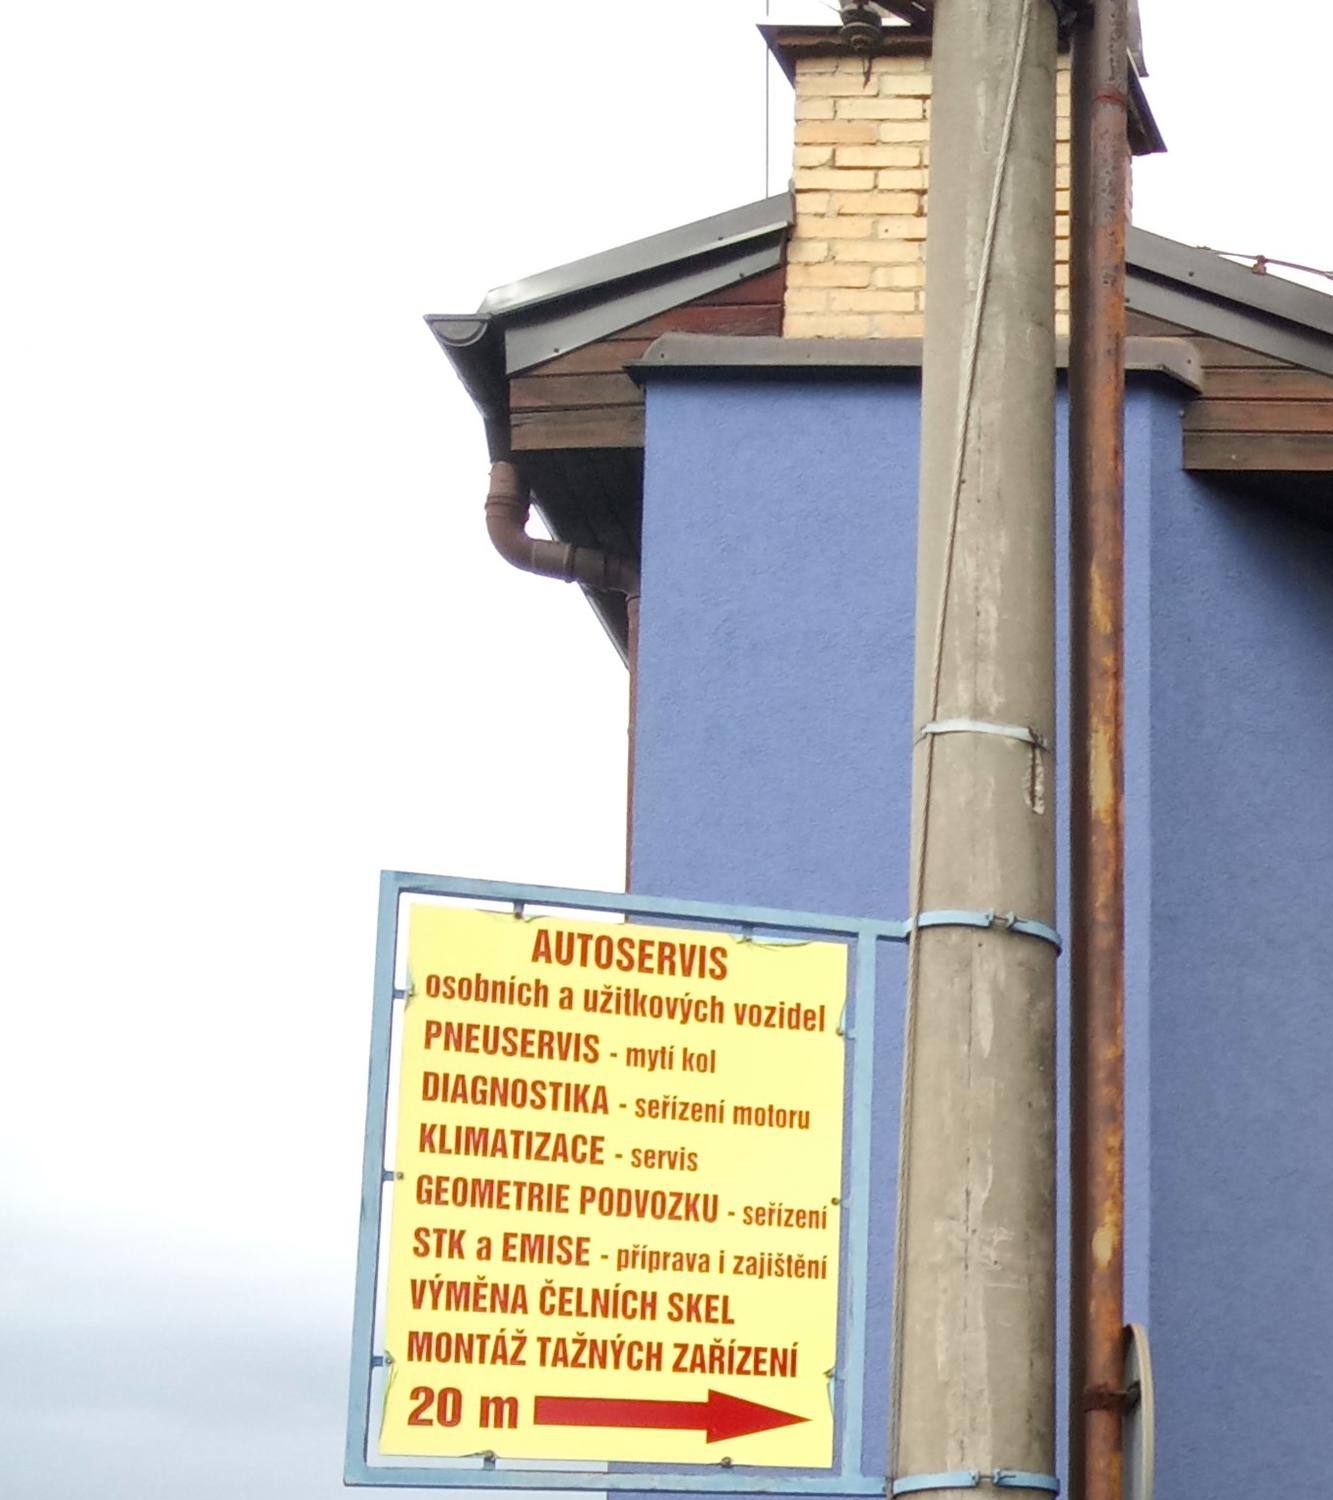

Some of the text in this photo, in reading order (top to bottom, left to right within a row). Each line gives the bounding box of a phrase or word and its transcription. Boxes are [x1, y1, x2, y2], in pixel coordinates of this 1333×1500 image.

[532, 928, 728, 981] AUTOSERVIS
[425, 972, 826, 1032] osobních a užitkových vozidel
[424, 1019, 600, 1064] PNEUSERVIS
[626, 1043, 675, 1072] mytí
[682, 1047, 716, 1074] kol
[422, 1071, 609, 1115] DIAGNOSTIKA
[635, 1094, 725, 1124] seřízení
[733, 1104, 811, 1130] motoru
[419, 1123, 605, 1165] KLIMATIZACE
[631, 1145, 698, 1172] servis
[416, 1174, 570, 1214] GEOMETRIE
[579, 1185, 719, 1223] PODVOZKU
[743, 1201, 828, 1230] seřízení
[412, 1227, 466, 1260] STK
[476, 1236, 492, 1261] a
[502, 1232, 591, 1267] EMISE
[616, 1244, 711, 1274] příprava
[719, 1249, 725, 1274] i
[732, 1251, 828, 1280] zajištění
[410, 1276, 735, 1325] VÝMĚNA ČELNÍCH SKEL
[407, 1328, 800, 1378] MONTÁŽ TAŽNÝCH ZAŘÍZENÍ
[407, 1385, 519, 1429] 20 m
